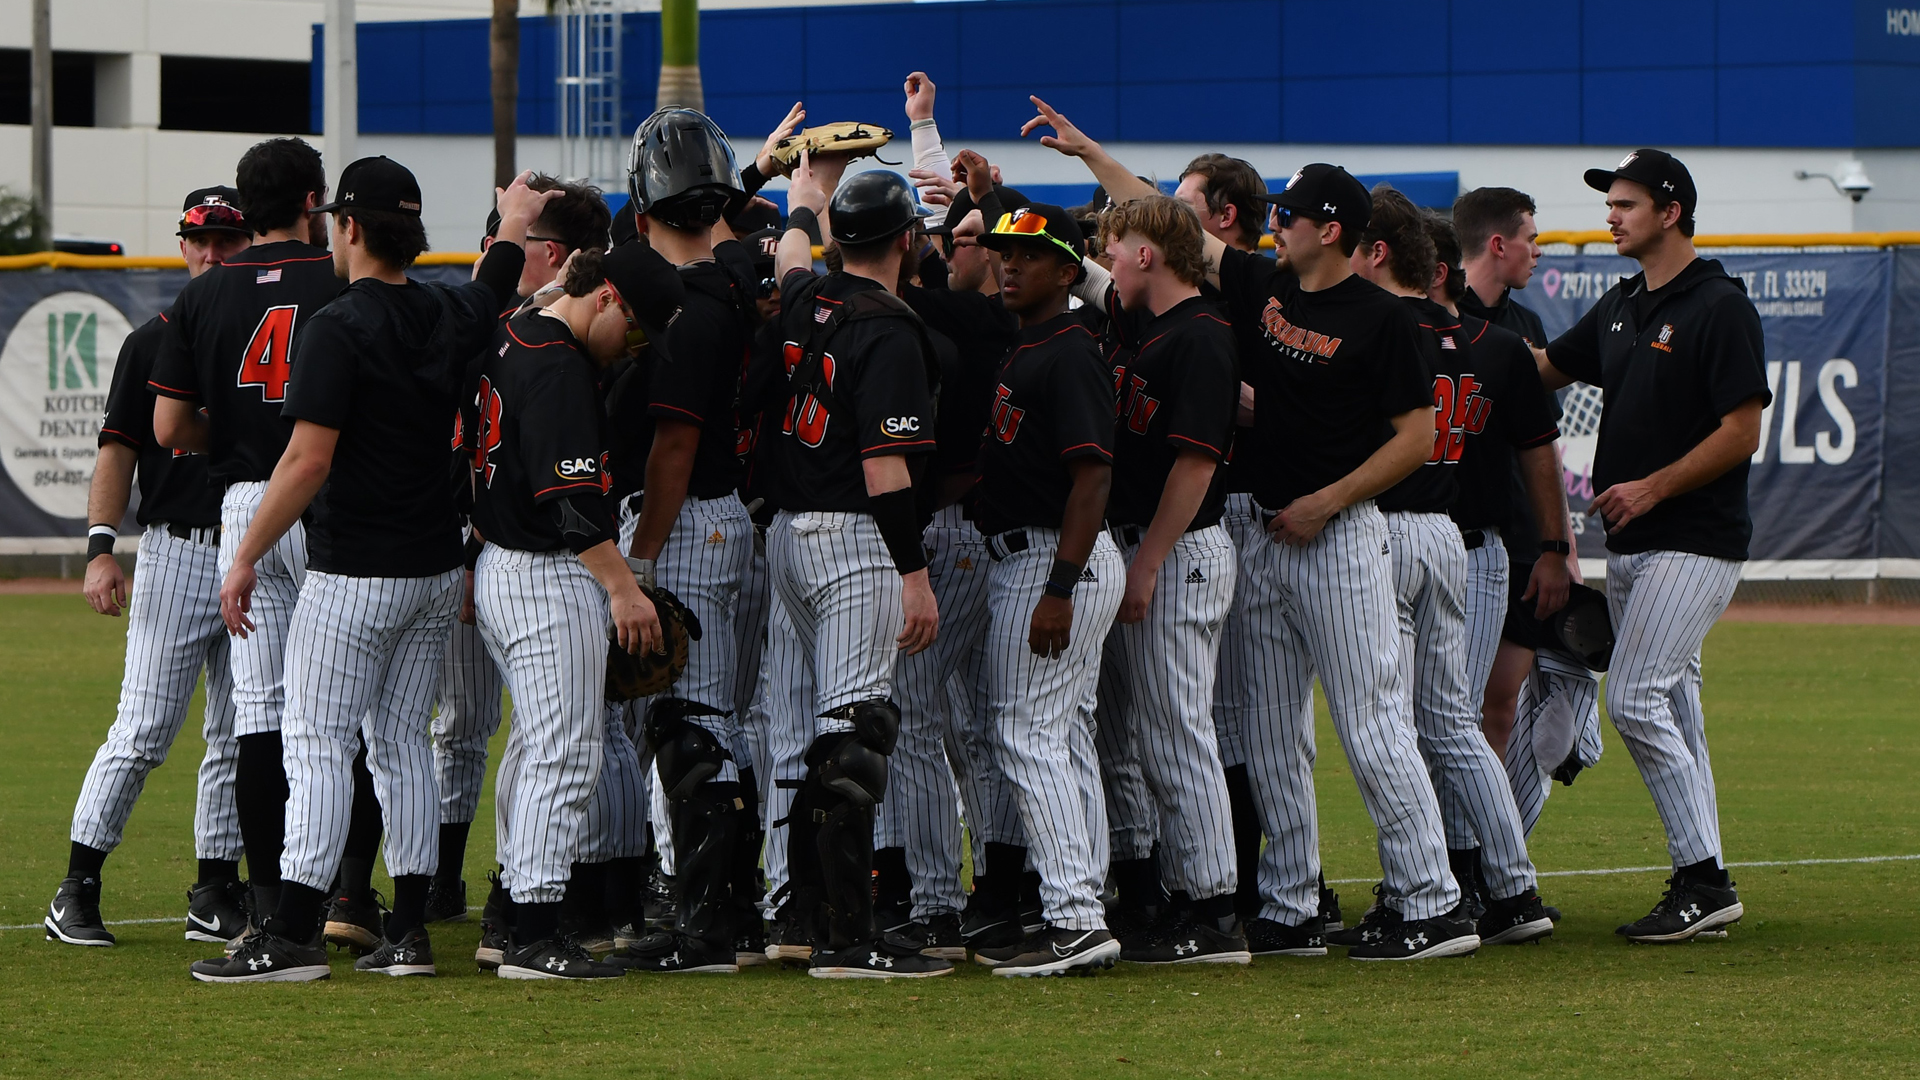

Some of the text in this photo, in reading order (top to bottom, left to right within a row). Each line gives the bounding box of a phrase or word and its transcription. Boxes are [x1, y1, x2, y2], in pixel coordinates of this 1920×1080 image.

[1764, 270, 1779, 298] FL
[1784, 270, 1827, 298] 33324
[237, 304, 298, 403] 4
[45, 396, 106, 414] KOTCH
[991, 383, 1026, 445] TU
[1124, 374, 1161, 436] TU
[40, 419, 101, 437] DENTA
[885, 416, 920, 433] SAC
[560, 457, 596, 475] SAC
